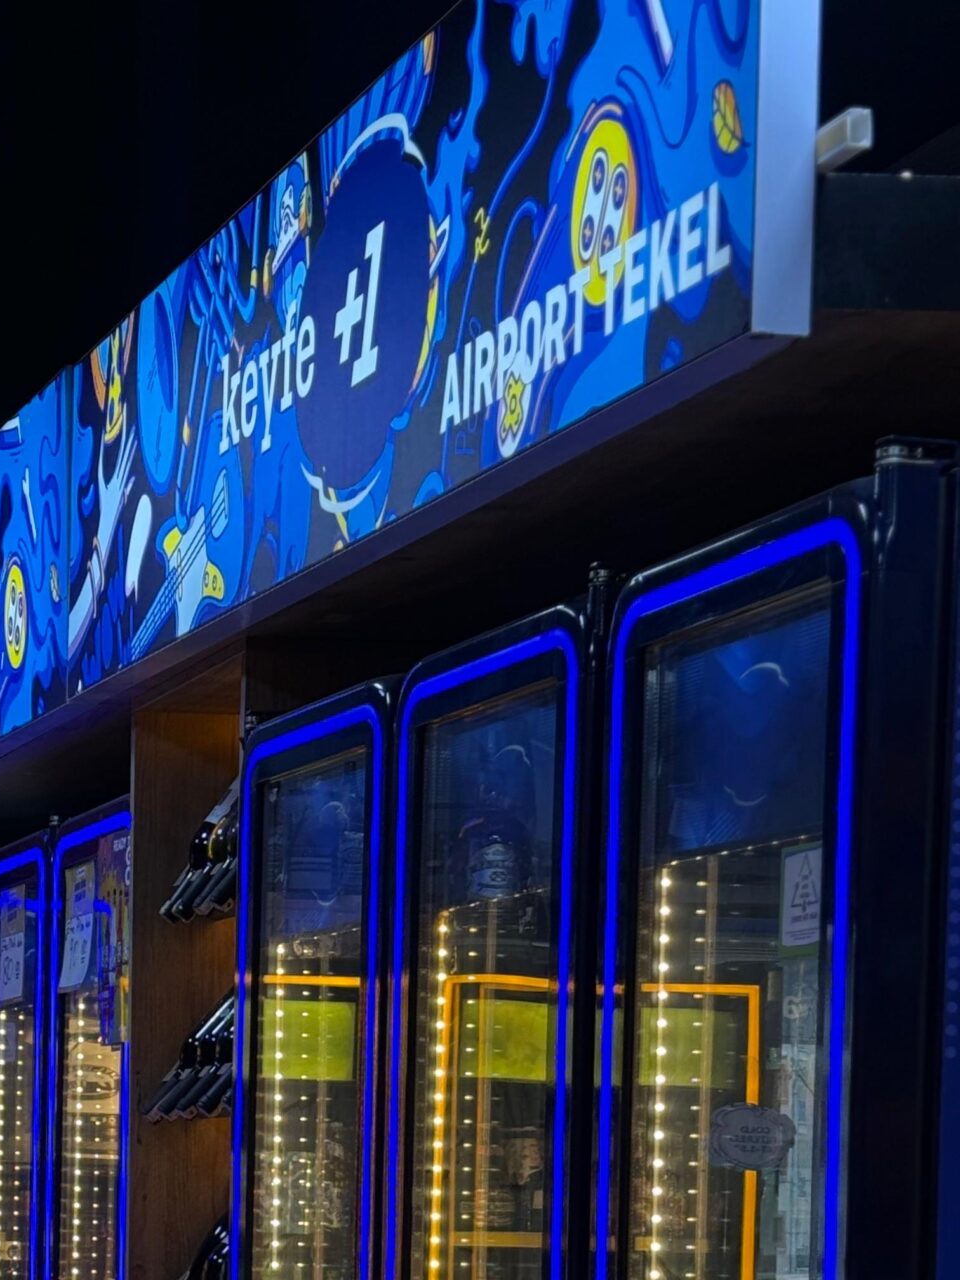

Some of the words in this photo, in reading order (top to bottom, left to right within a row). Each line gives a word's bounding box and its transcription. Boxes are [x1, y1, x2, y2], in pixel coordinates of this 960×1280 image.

[219, 299, 315, 456] keyfe
[334, 220, 385, 387] +1
[440, 267, 590, 434] AIRPORT
[600, 182, 731, 337] TEKEL
